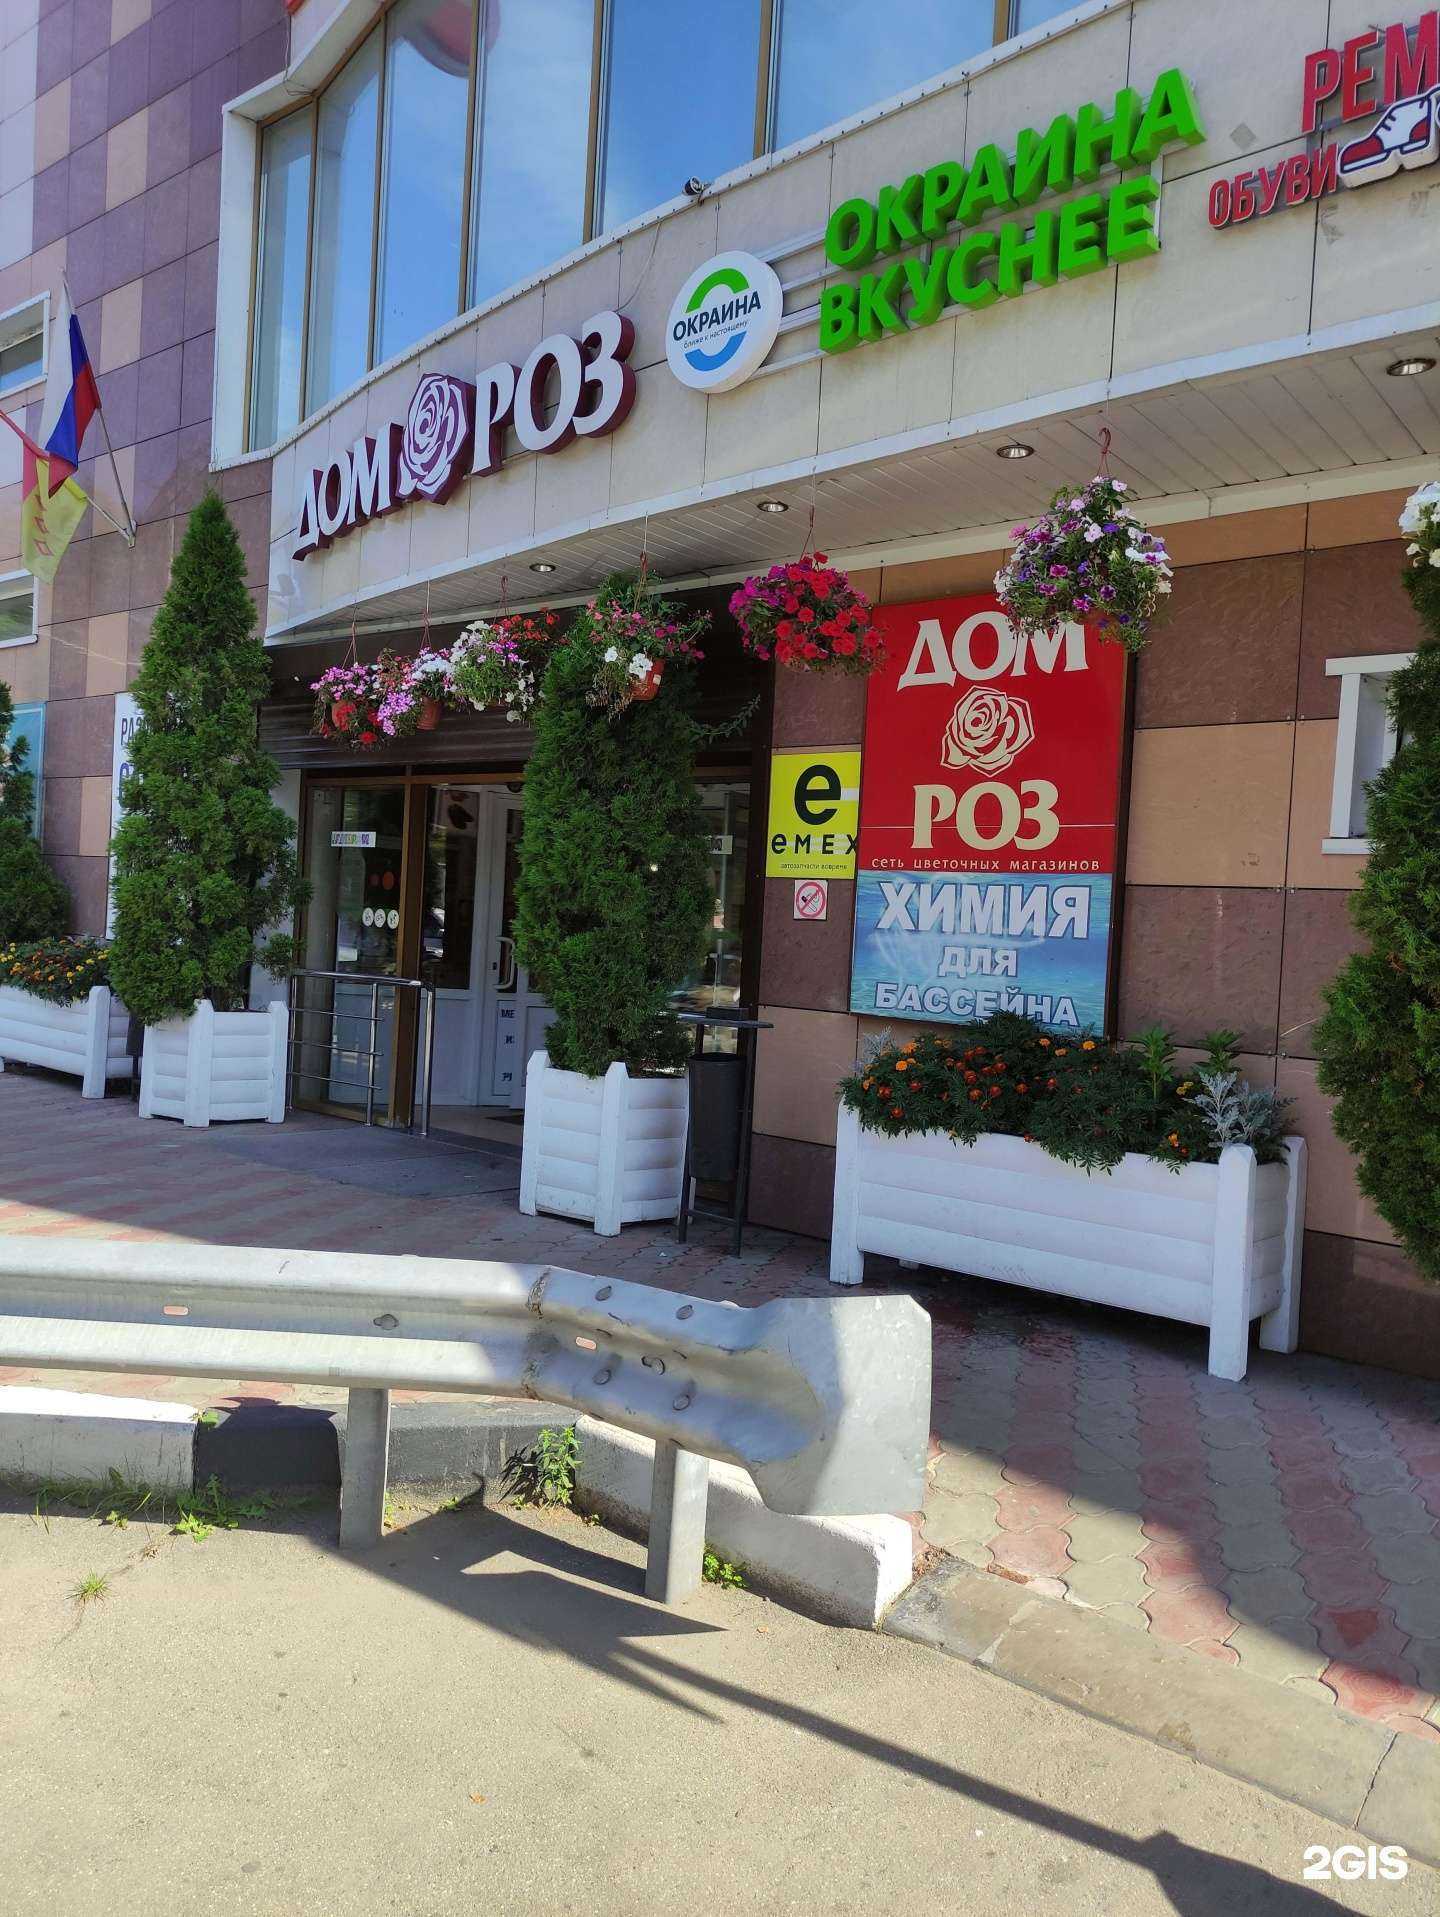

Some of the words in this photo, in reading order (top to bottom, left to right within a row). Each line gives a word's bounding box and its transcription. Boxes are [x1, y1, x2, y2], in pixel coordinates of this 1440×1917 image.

[825, 68, 1207, 271] ОКРАИНА
[1208, 143, 1339, 230] ОБУВИ
[820, 175, 1161, 354] ВКУСНЕЕ
[673, 291, 761, 341] ОКРАИНА
[293, 422, 402, 560] ДОМ
[470, 310, 634, 477] РОЗ
[897, 611, 1089, 692] ДОМ
[911, 779, 1060, 851] РОЗ
[871, 858, 904, 868] сеть
[914, 858, 1000, 870] цветочных
[1009, 859, 1100, 871] магазинов
[876, 881, 1092, 939] ХИМИЯ
[874, 982, 1080, 1027] БАССЕЙНА
